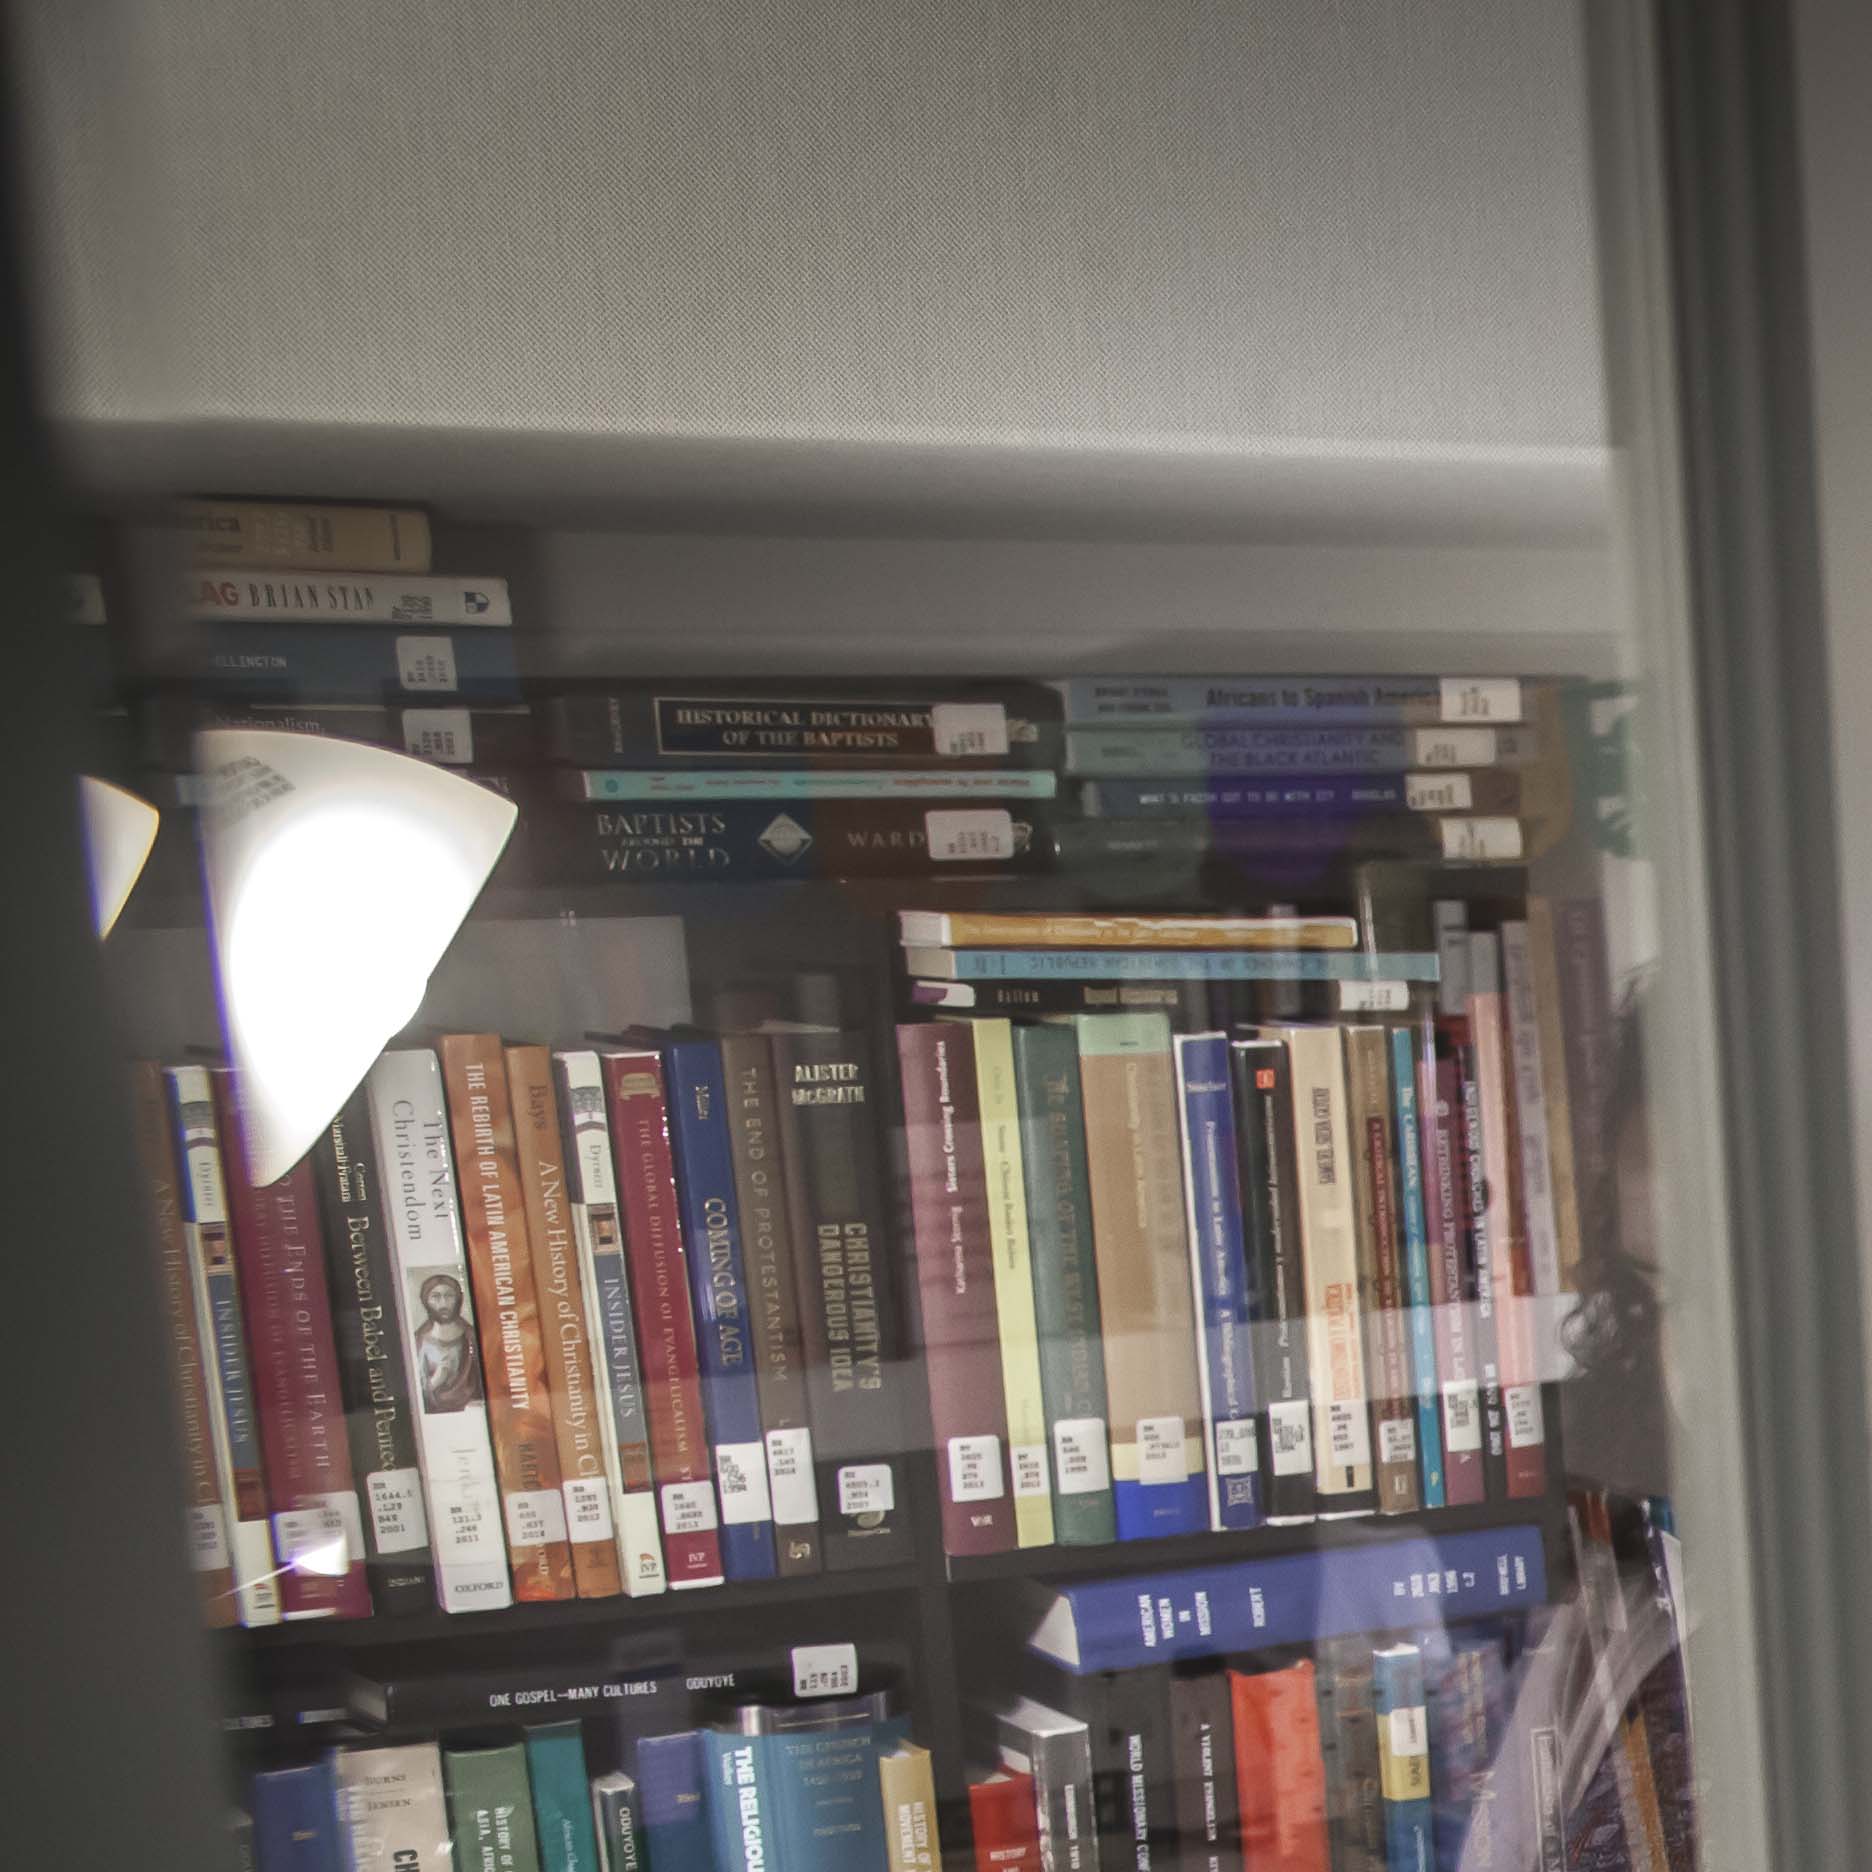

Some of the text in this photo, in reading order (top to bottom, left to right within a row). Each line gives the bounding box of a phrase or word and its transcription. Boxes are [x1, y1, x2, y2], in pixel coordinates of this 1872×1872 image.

[249, 583, 319, 610] BRIAN
[677, 709, 801, 727] HISTORICAL
[722, 731, 899, 748] OF THE BAPTISTS
[598, 813, 726, 836] BAPTISTS
[601, 848, 731, 871] WORLD
[795, 1063, 859, 1083] ALISTER
[936, 1040, 960, 1193] Sisters Crossing Boundaries
[391, 1099, 427, 1242] Christendom
[423, 1120, 450, 1219] The Next
[464, 1064, 531, 1410] THE REBIRTH OF LATIN AMERICAN CHRISTIANITY
[743, 1066, 790, 1384] THE END OF PROTESTANTISM
[1435, 1129, 1463, 1333] RETHINKING PROTESTANTISM
[538, 1160, 591, 1451] A New History of Christianity in
[704, 1197, 744, 1367] COMING OF AGE
[817, 1223, 855, 1393] DANGEROUS IDEA
[844, 1223, 882, 1391] CHRISTIANITY'S
[347, 1215, 394, 1403] Between Babel and
[603, 1277, 640, 1418] INSIDER JESUS
[301, 1392, 330, 1469] EARTH
[1137, 1594, 1157, 1647] AMERICAN
[1158, 1598, 1175, 1640] WOMEN
[1178, 1610, 1192, 1623] IN
[1194, 1591, 1212, 1636] MISSION
[489, 1693, 512, 1708] ONE
[602, 1680, 658, 1699] CULTURES
[735, 1745, 757, 1786] THE
[1128, 1734, 1144, 1772] WORLD
[1200, 1734, 1214, 1777] VIOLENT
[494, 1806, 512, 1850] HISTORY
[898, 1803, 918, 1865] MOVEMENT
[912, 1801, 929, 1855] HISTORY
[1131, 1774, 1149, 1842] MISSIONARY
[1203, 1781, 1218, 1842] EVANGELISM
[500, 1854, 514, 1867] OF
[618, 1806, 639, 1872] ODUYOYE
[919, 1852, 932, 1866] OF
[989, 1846, 1028, 1862] HISTORY
[1069, 1845, 1081, 1870] 1910
